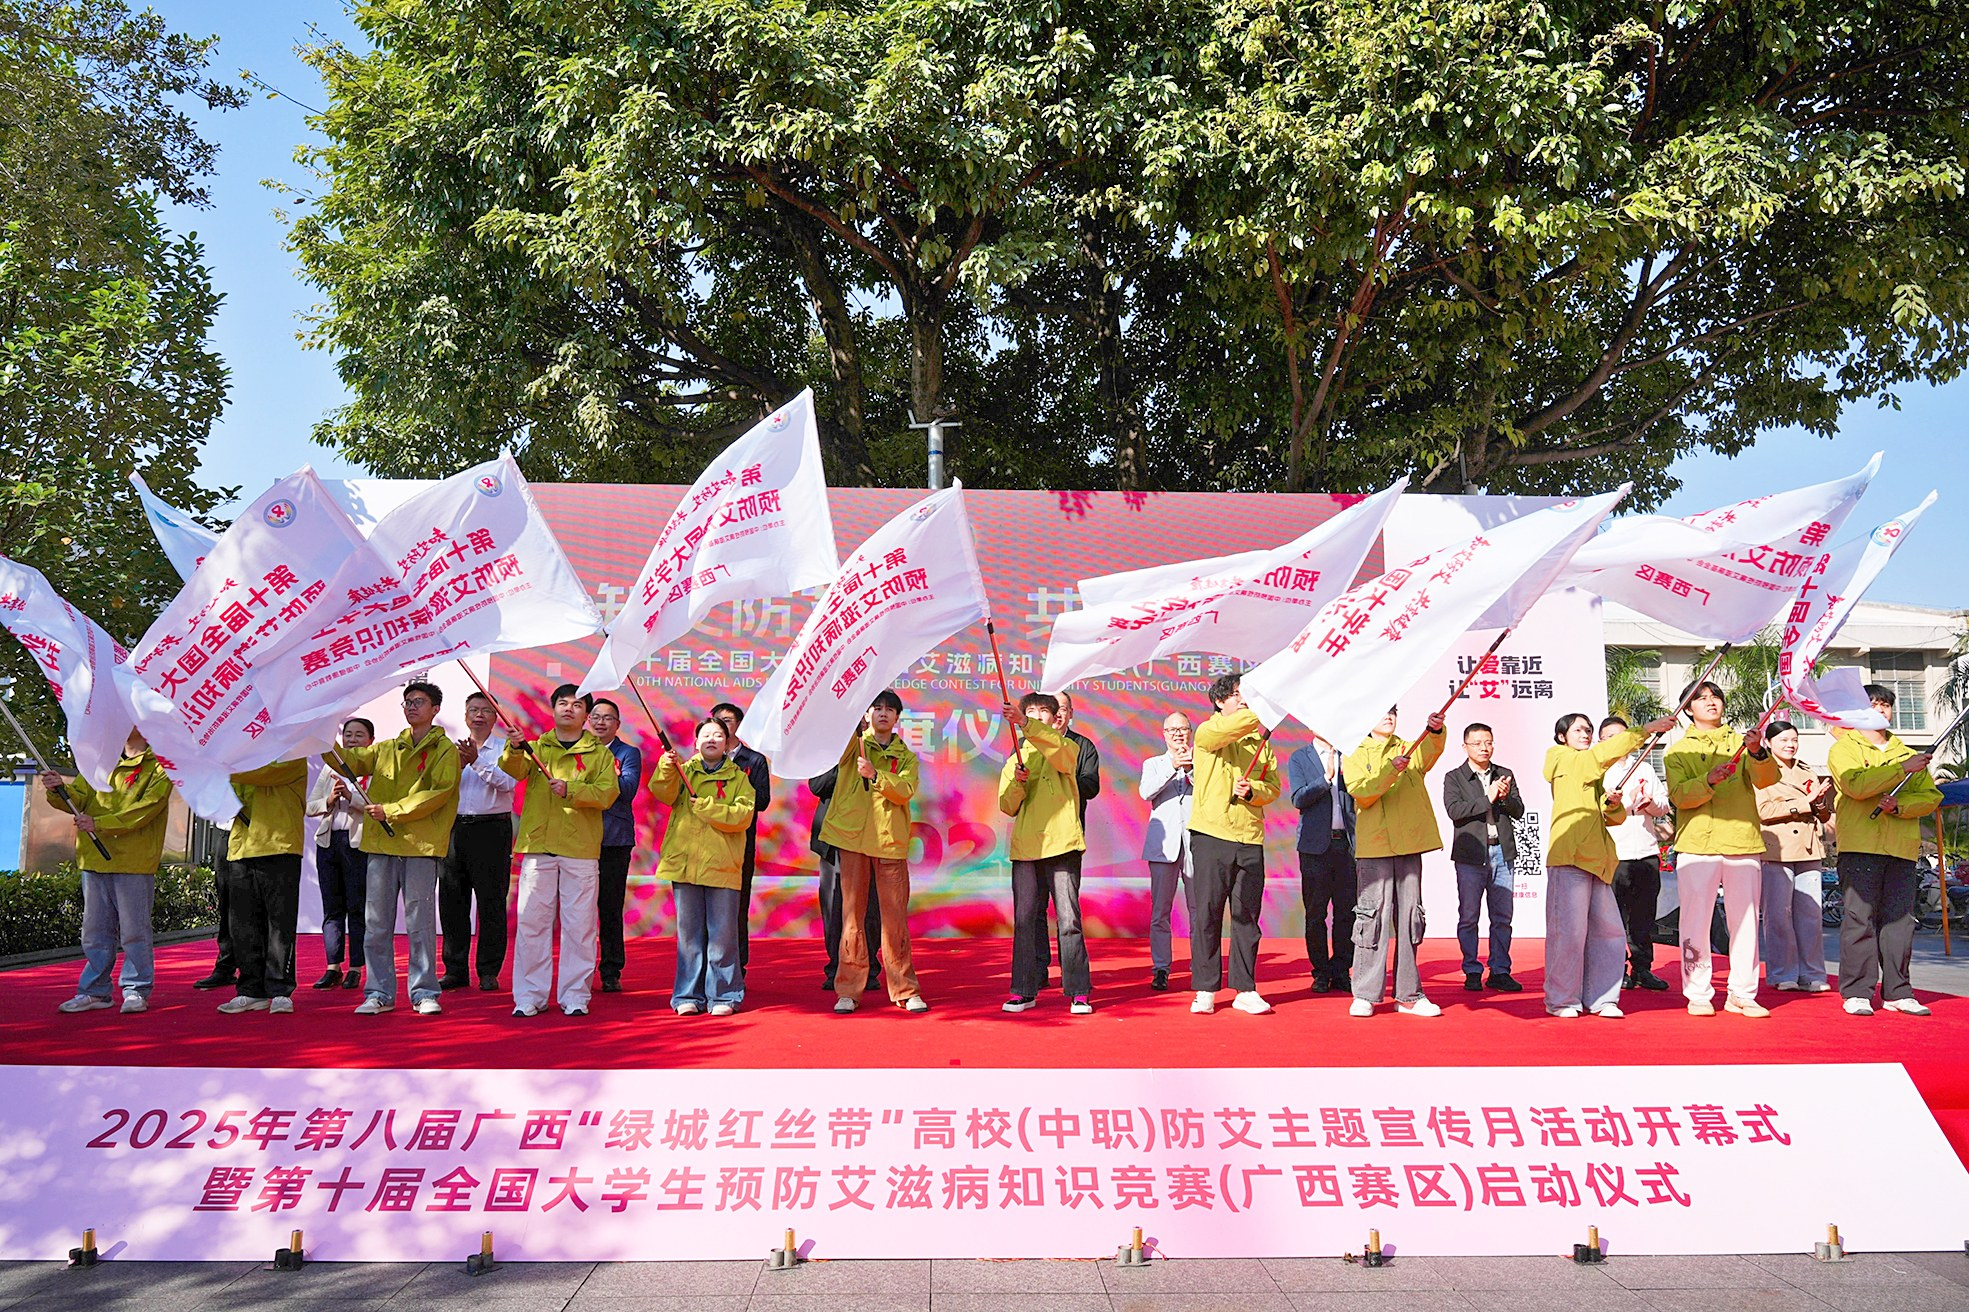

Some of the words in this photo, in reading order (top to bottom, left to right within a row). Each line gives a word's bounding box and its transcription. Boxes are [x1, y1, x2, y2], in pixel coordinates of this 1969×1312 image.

[1457, 655, 1543, 675] 让爱靠近
[664, 677, 729, 688] NATIONAL
[733, 677, 763, 688] AIDS
[930, 679, 987, 690] CONTEST
